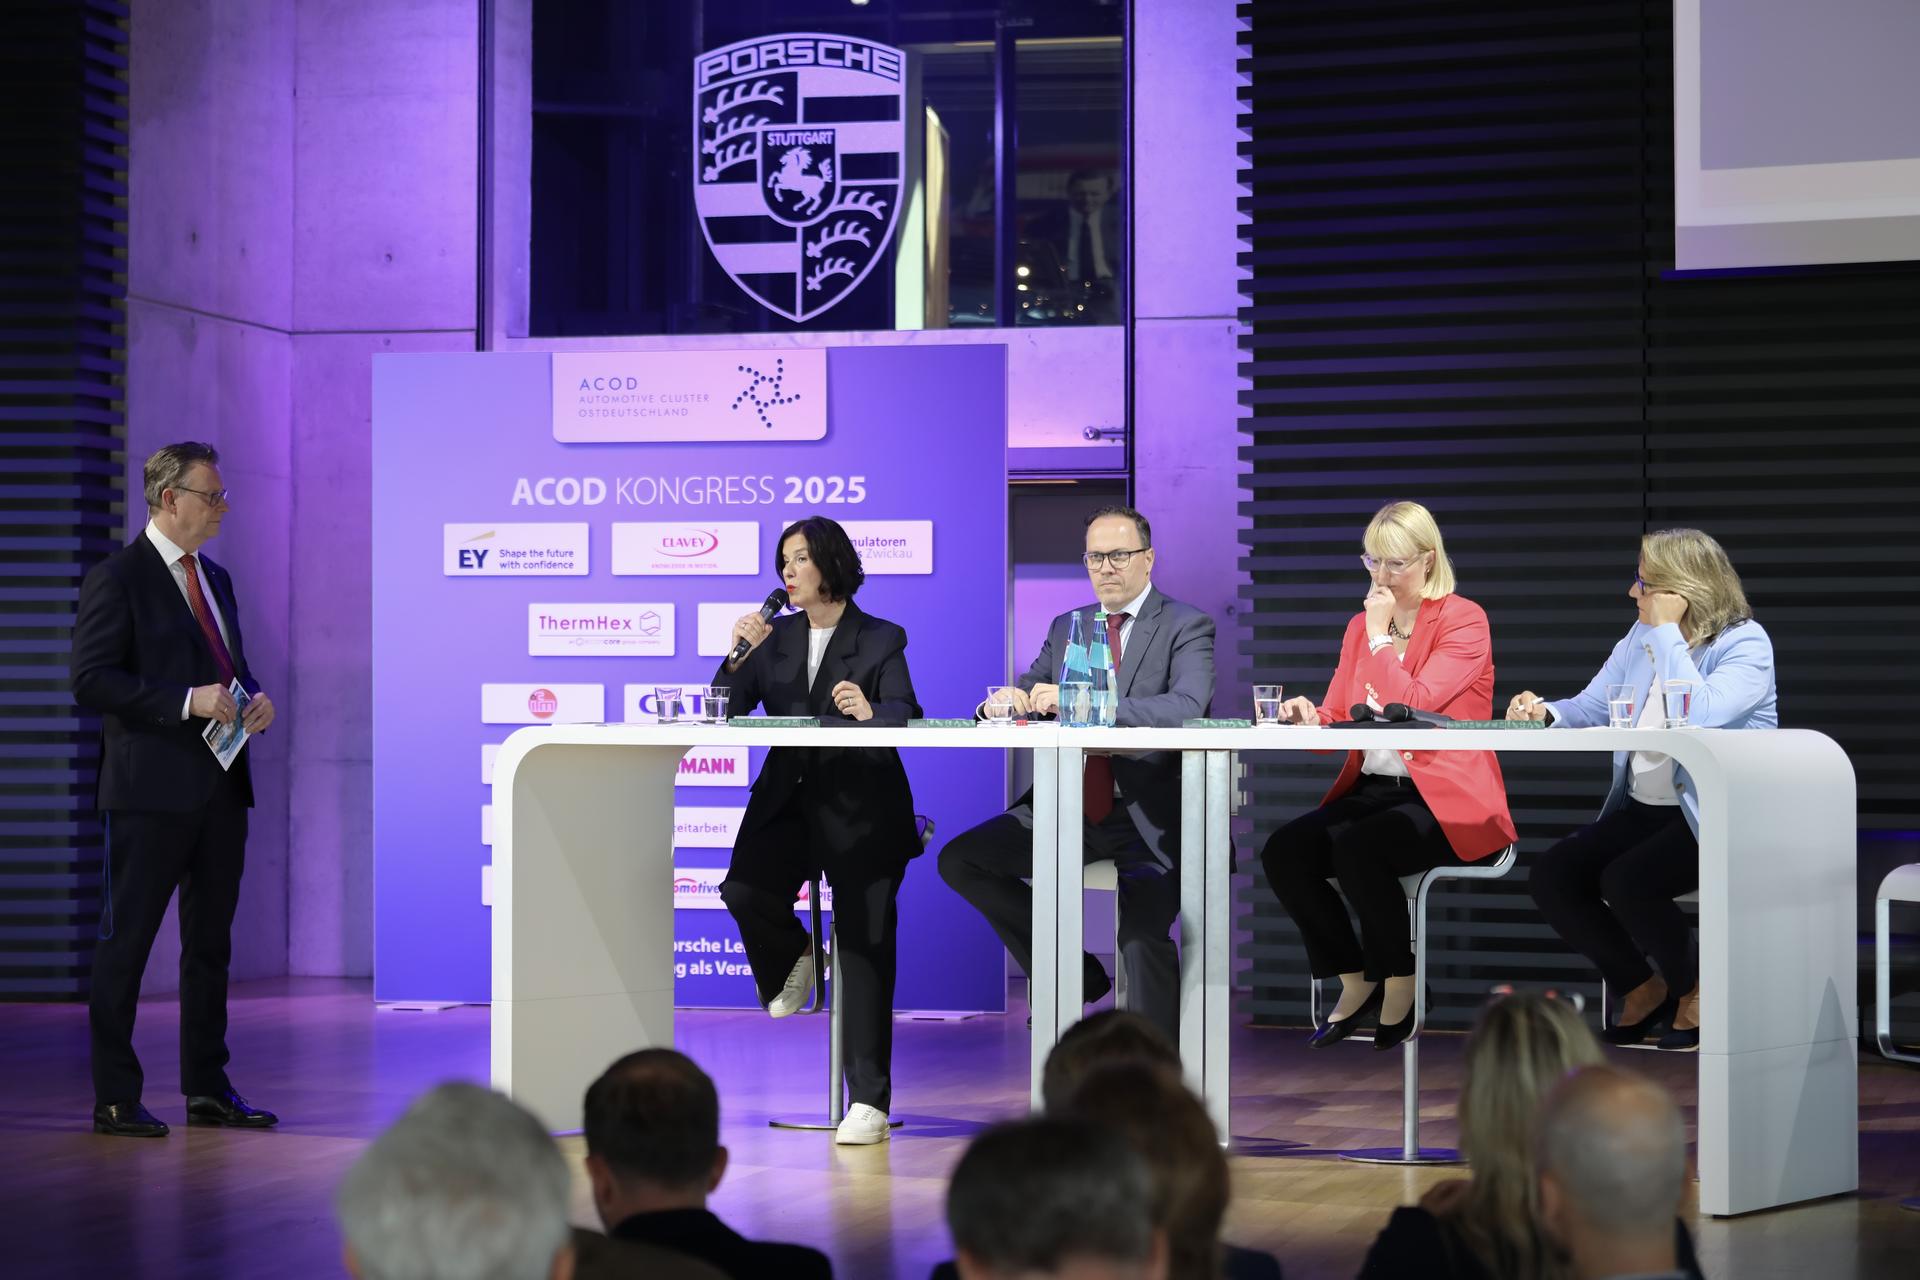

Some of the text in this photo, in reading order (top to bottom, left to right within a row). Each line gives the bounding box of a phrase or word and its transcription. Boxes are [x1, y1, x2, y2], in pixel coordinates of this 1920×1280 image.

[701, 40, 900, 85] PORSCHE
[767, 131, 833, 147] STUTTGART
[579, 377, 638, 391] ACOD
[579, 394, 710, 404] AUTOMOTIVE CLUSTER
[578, 408, 689, 418] OSTDEUTSCHLAND
[511, 475, 867, 506] ACOD KONGRESS 2025
[662, 537, 706, 548] CLAVEY
[458, 549, 489, 569] EY
[499, 549, 574, 559] Shape the future
[866, 548, 913, 559] Zwickau
[499, 561, 574, 569] with confidence
[539, 616, 632, 630] ThermHex
[676, 758, 735, 774] MANN
[689, 959, 713, 975] als
